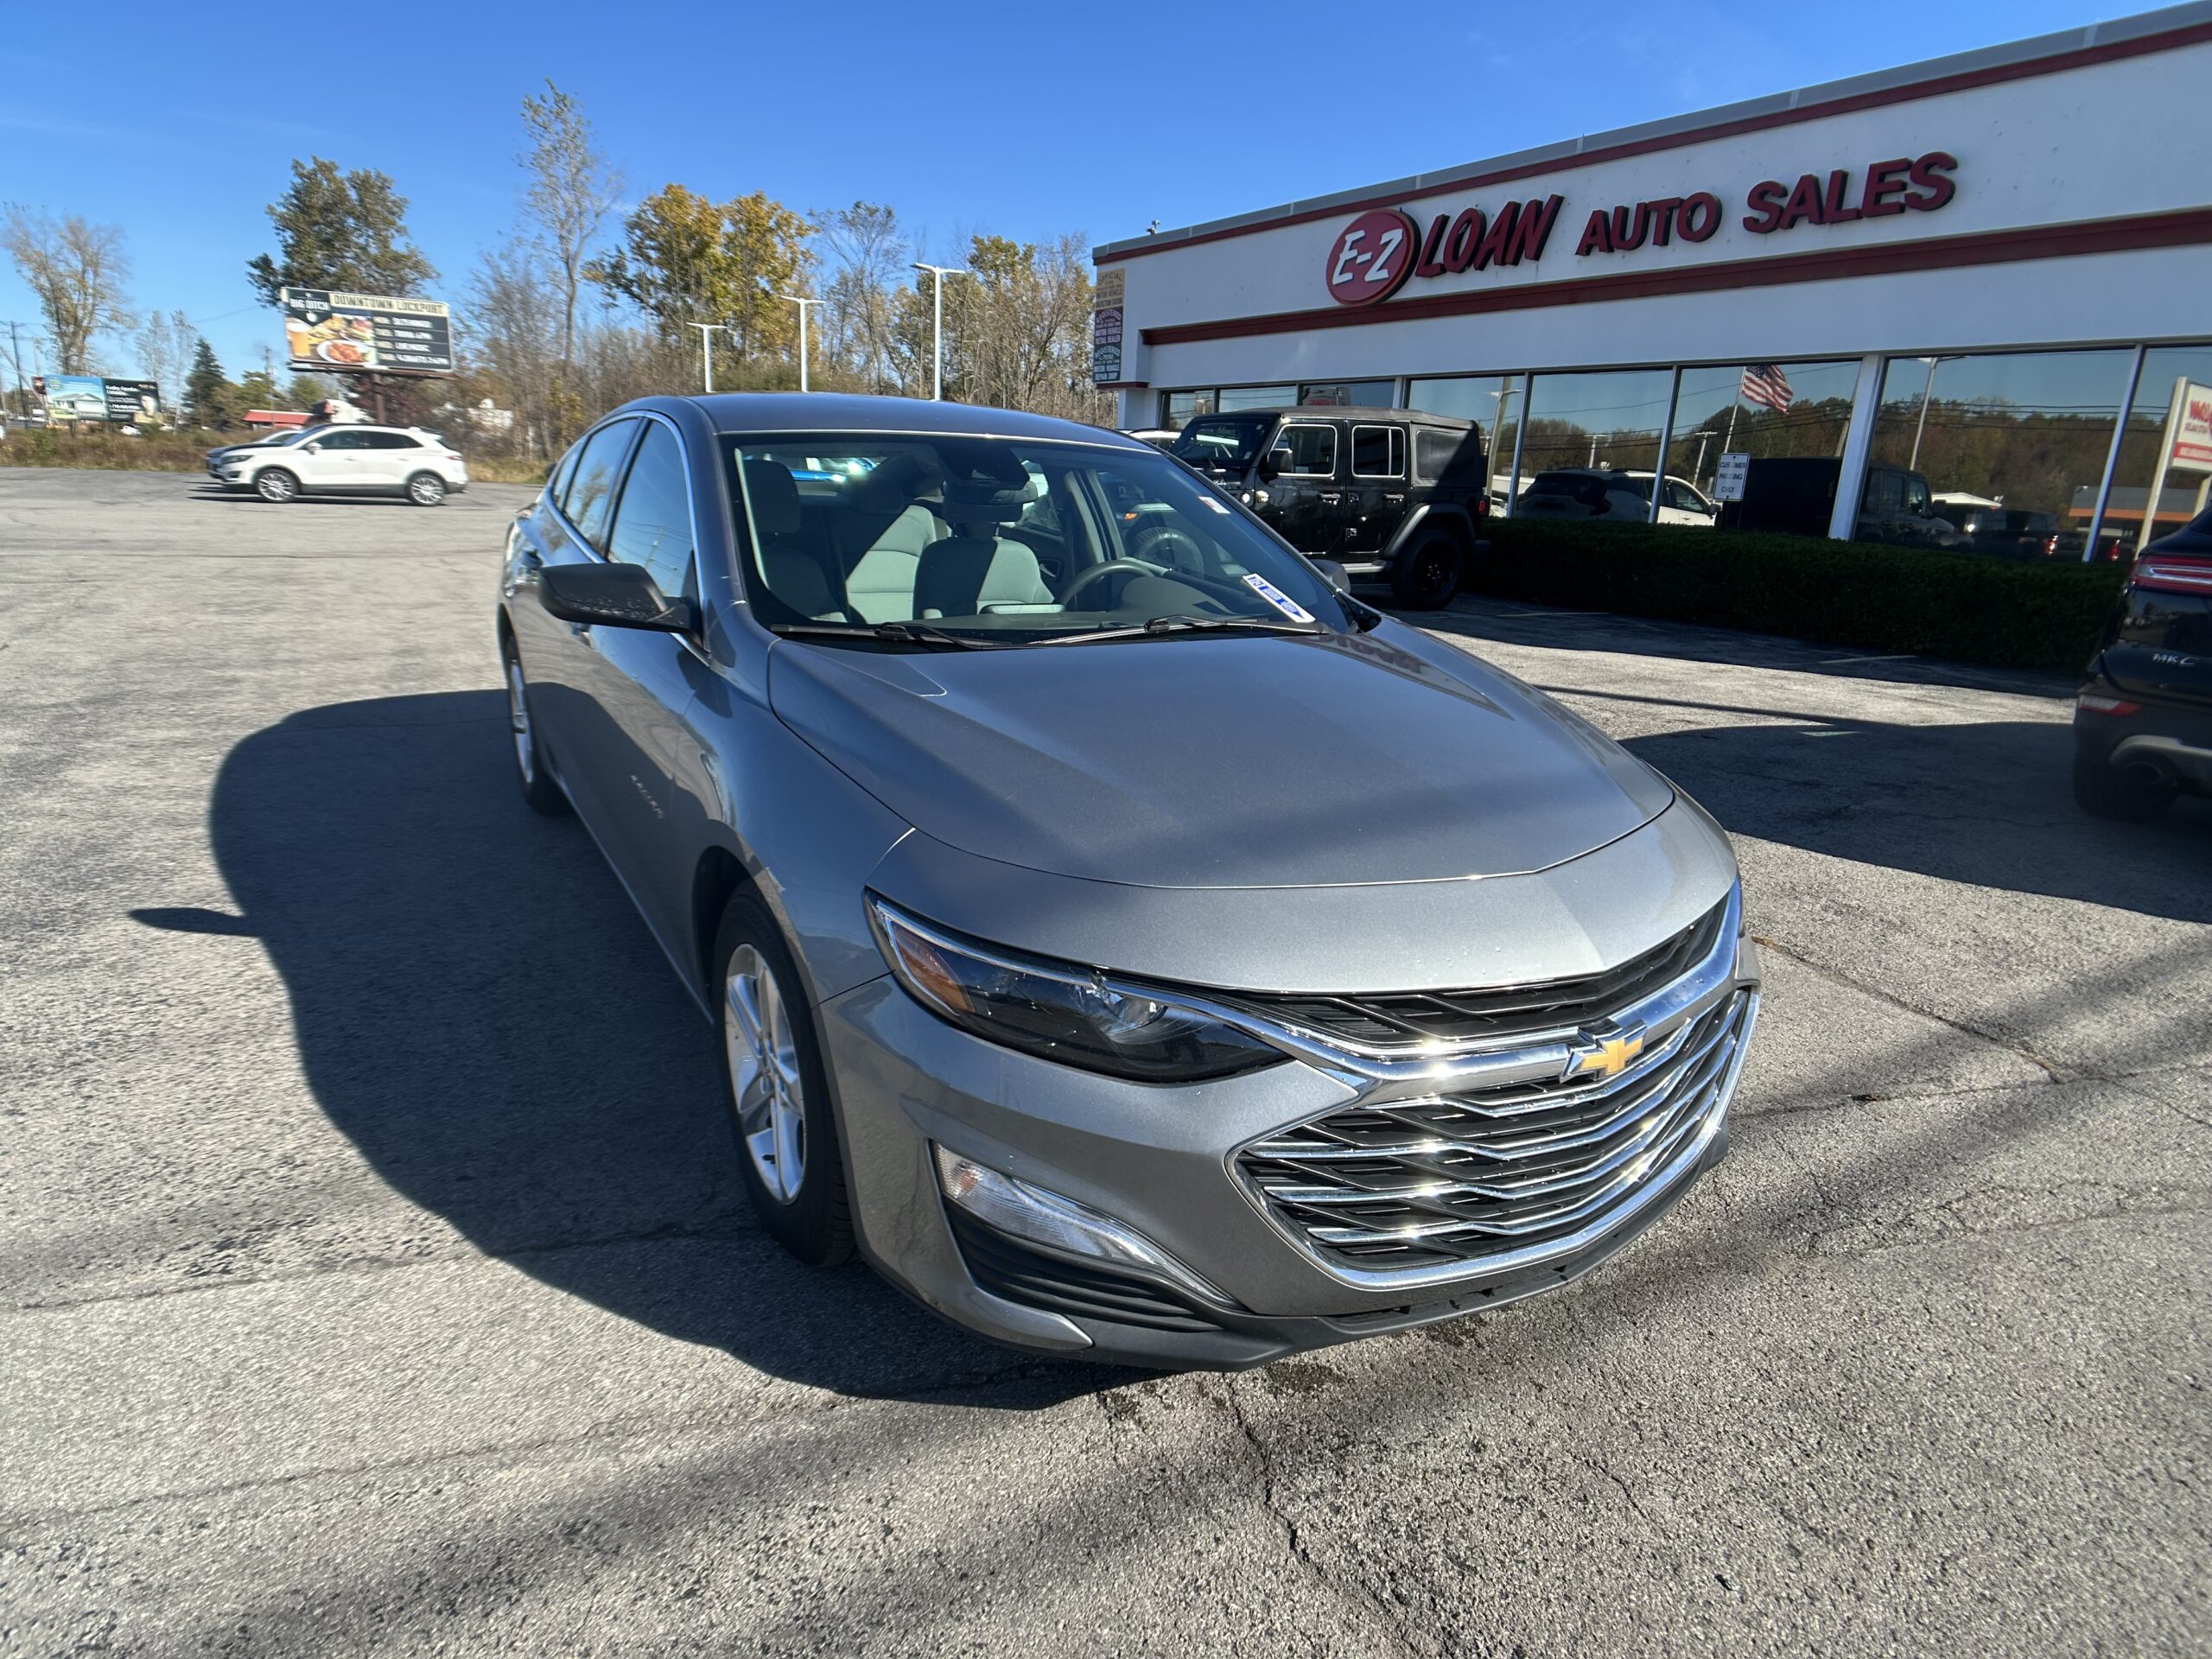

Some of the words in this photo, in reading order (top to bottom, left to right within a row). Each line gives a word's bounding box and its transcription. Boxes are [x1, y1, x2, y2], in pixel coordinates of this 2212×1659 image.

[1332, 228, 1404, 285] E-Z
[1414, 194, 1565, 277] LOAN
[1575, 192, 1723, 257] AUTO
[1742, 151, 1959, 234] SALES
[289, 298, 306, 308] BIG
[305, 299, 331, 311] DITCH
[334, 295, 393, 309] DOWNTOWN
[396, 300, 444, 314] LOCKPORT
[2152, 652, 2199, 665] MKC
